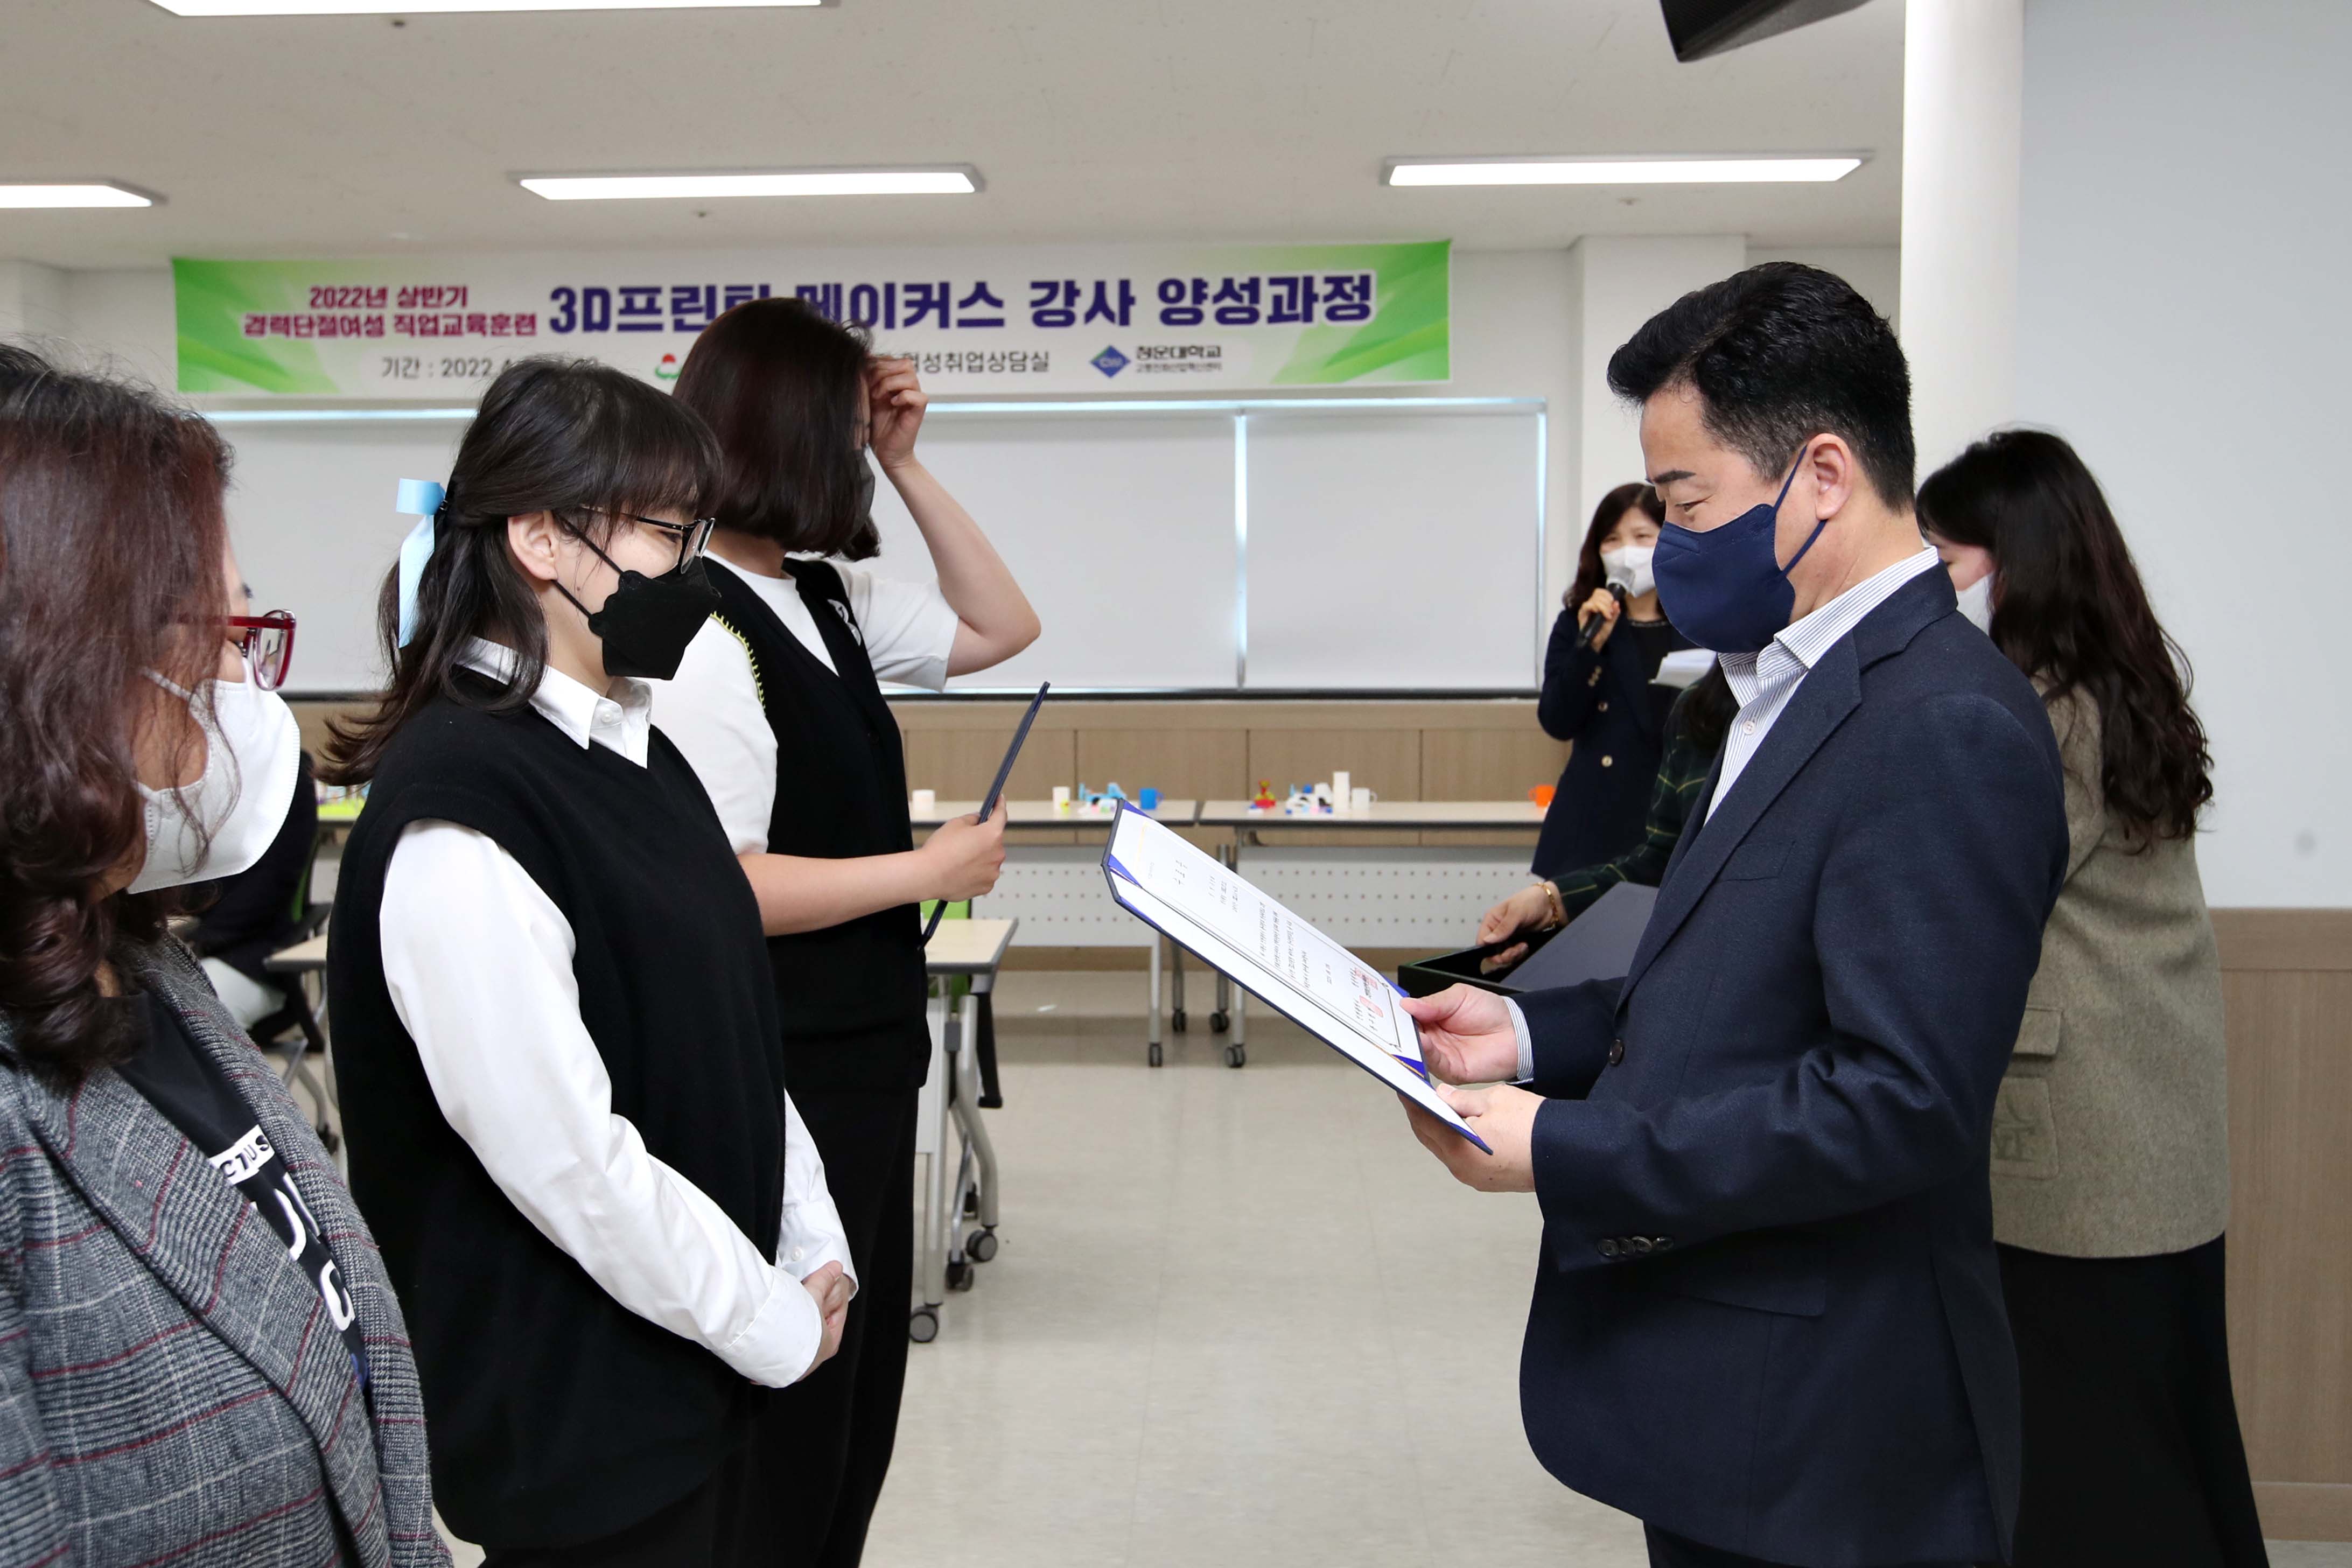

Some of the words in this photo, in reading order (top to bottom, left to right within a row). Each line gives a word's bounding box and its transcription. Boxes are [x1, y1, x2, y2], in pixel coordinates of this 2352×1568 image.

[310, 286, 388, 309] 2022년
[397, 286, 467, 309] 상반기
[795, 281, 1005, 330] 메이커스
[1030, 278, 1136, 327] 강사
[1157, 274, 1372, 326] 양성과정
[245, 312, 386, 338] 경력단절여성
[394, 312, 537, 338] 직업교육훈련
[382, 356, 420, 380] 기간
